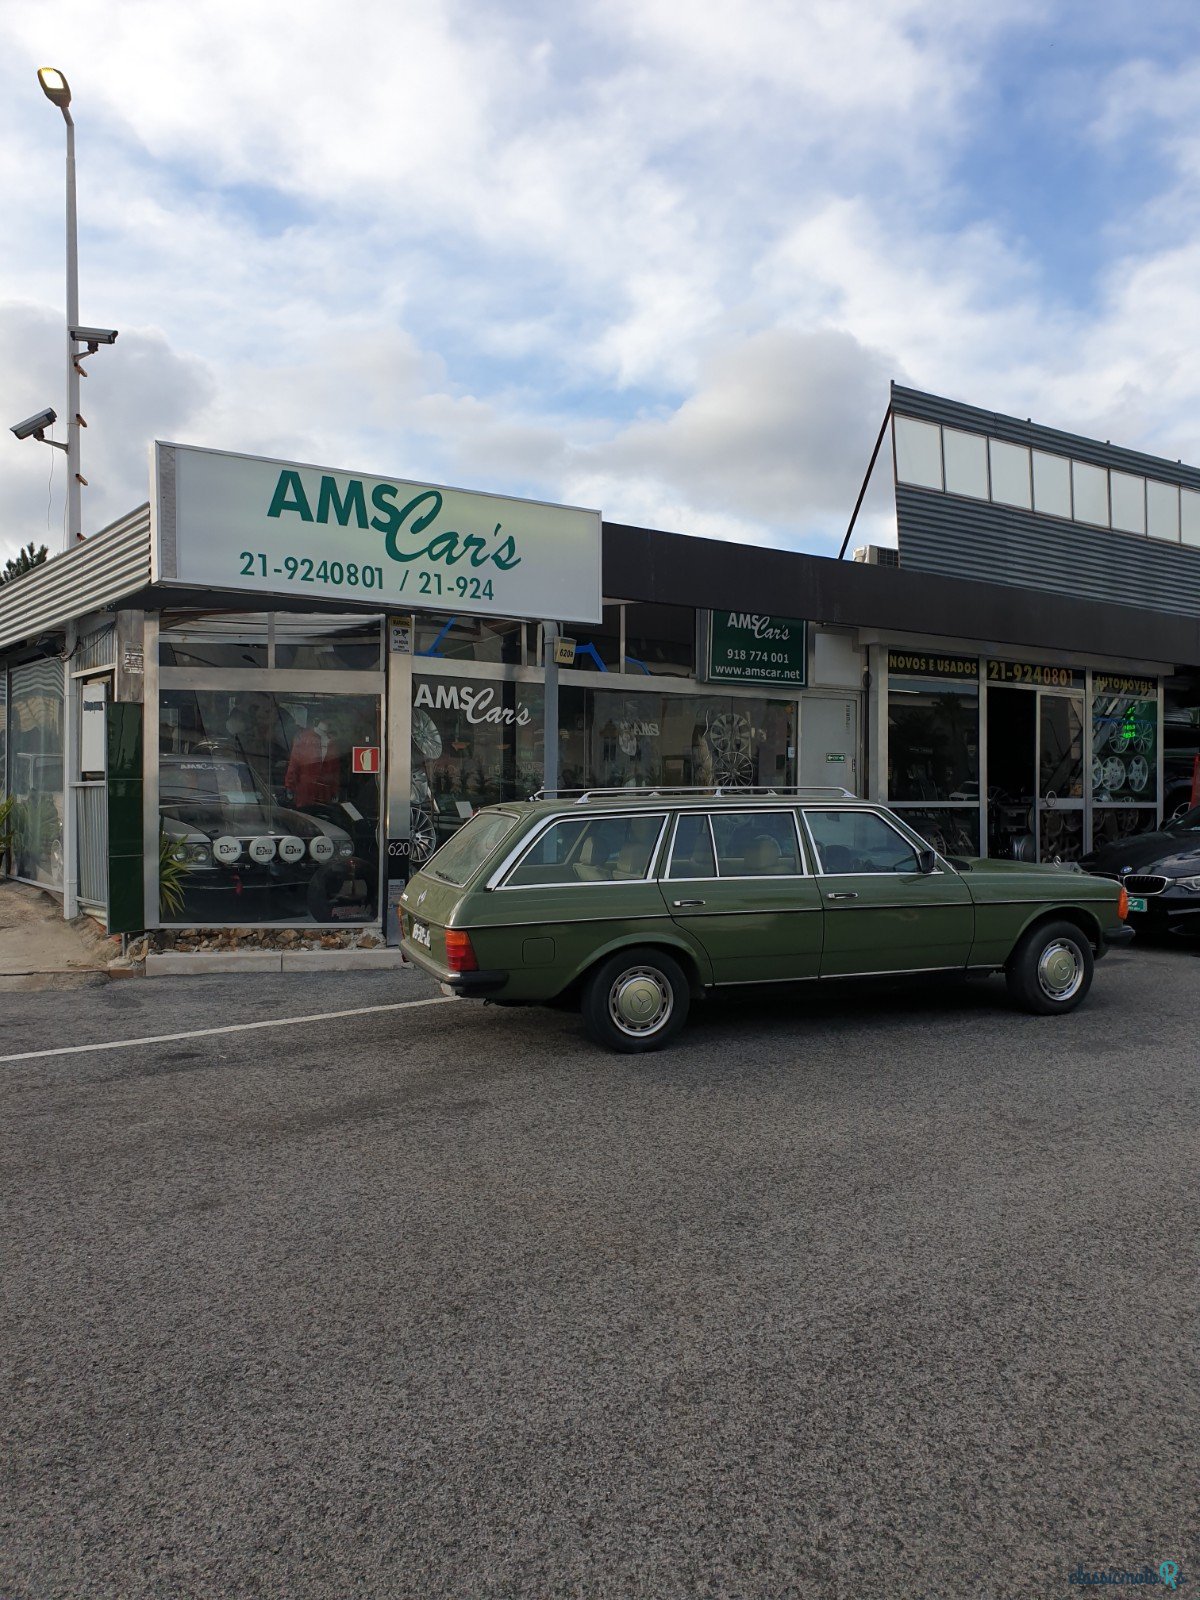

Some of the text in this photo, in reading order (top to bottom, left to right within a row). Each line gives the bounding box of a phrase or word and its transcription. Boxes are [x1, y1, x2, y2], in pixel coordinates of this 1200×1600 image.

[239, 551, 494, 600] 21-9240801 / 21-924
[727, 648, 789, 663] 918 774 001
[889, 654, 977, 675] NOVOS E USADOS
[715, 665, 800, 679] www.amscar.net
[989, 661, 1073, 687] 21-9240801
[388, 842, 410, 856] 620
